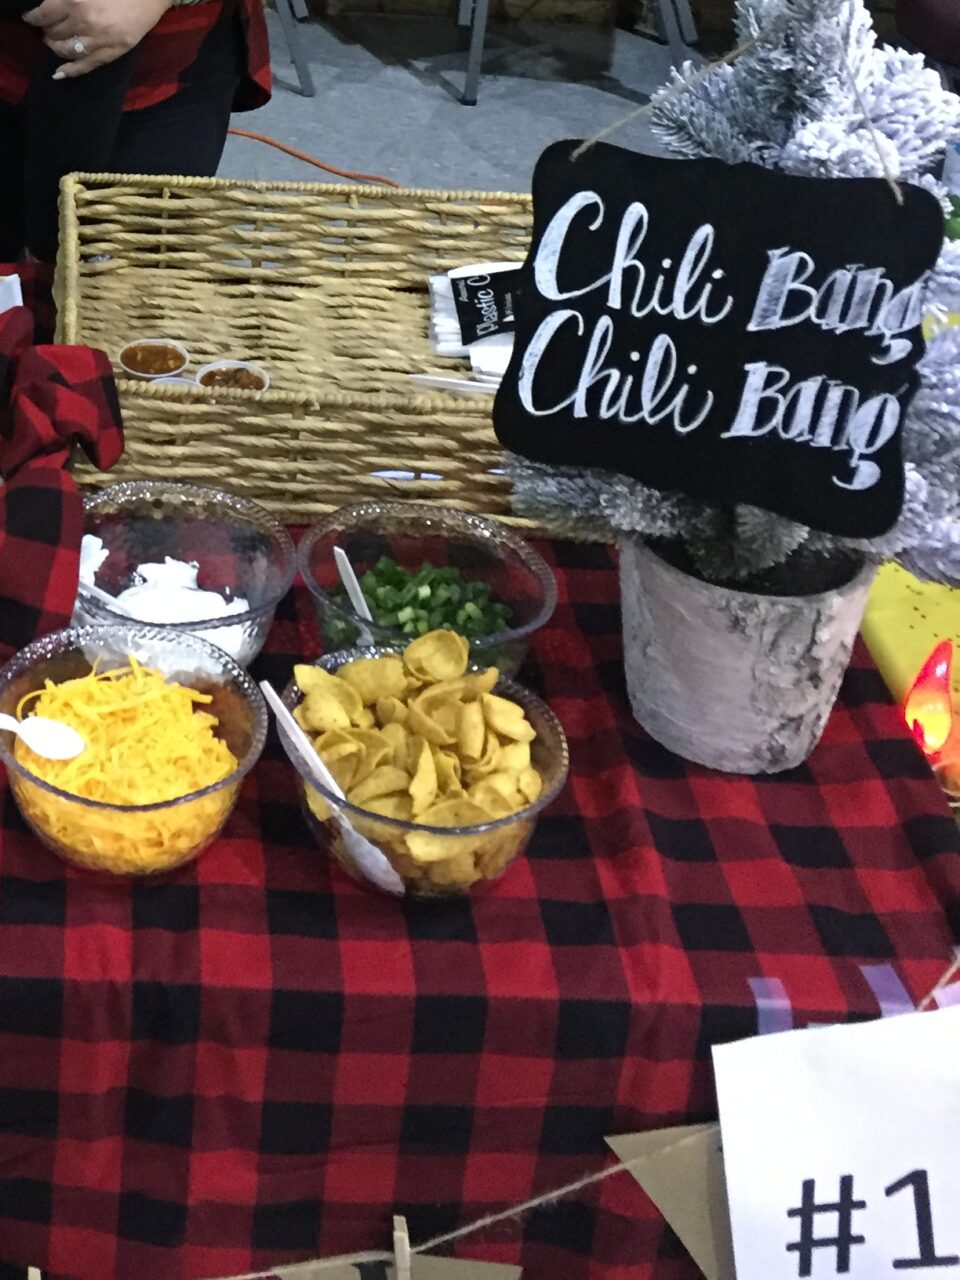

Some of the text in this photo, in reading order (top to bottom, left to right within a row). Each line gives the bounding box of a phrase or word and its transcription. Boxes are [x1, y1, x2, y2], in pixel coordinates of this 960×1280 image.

[474, 288, 499, 336] Plastic
[533, 190, 930, 365] Chili Bang
[518, 309, 909, 490] Chili Bang
[786, 1169, 960, 1278] #1
